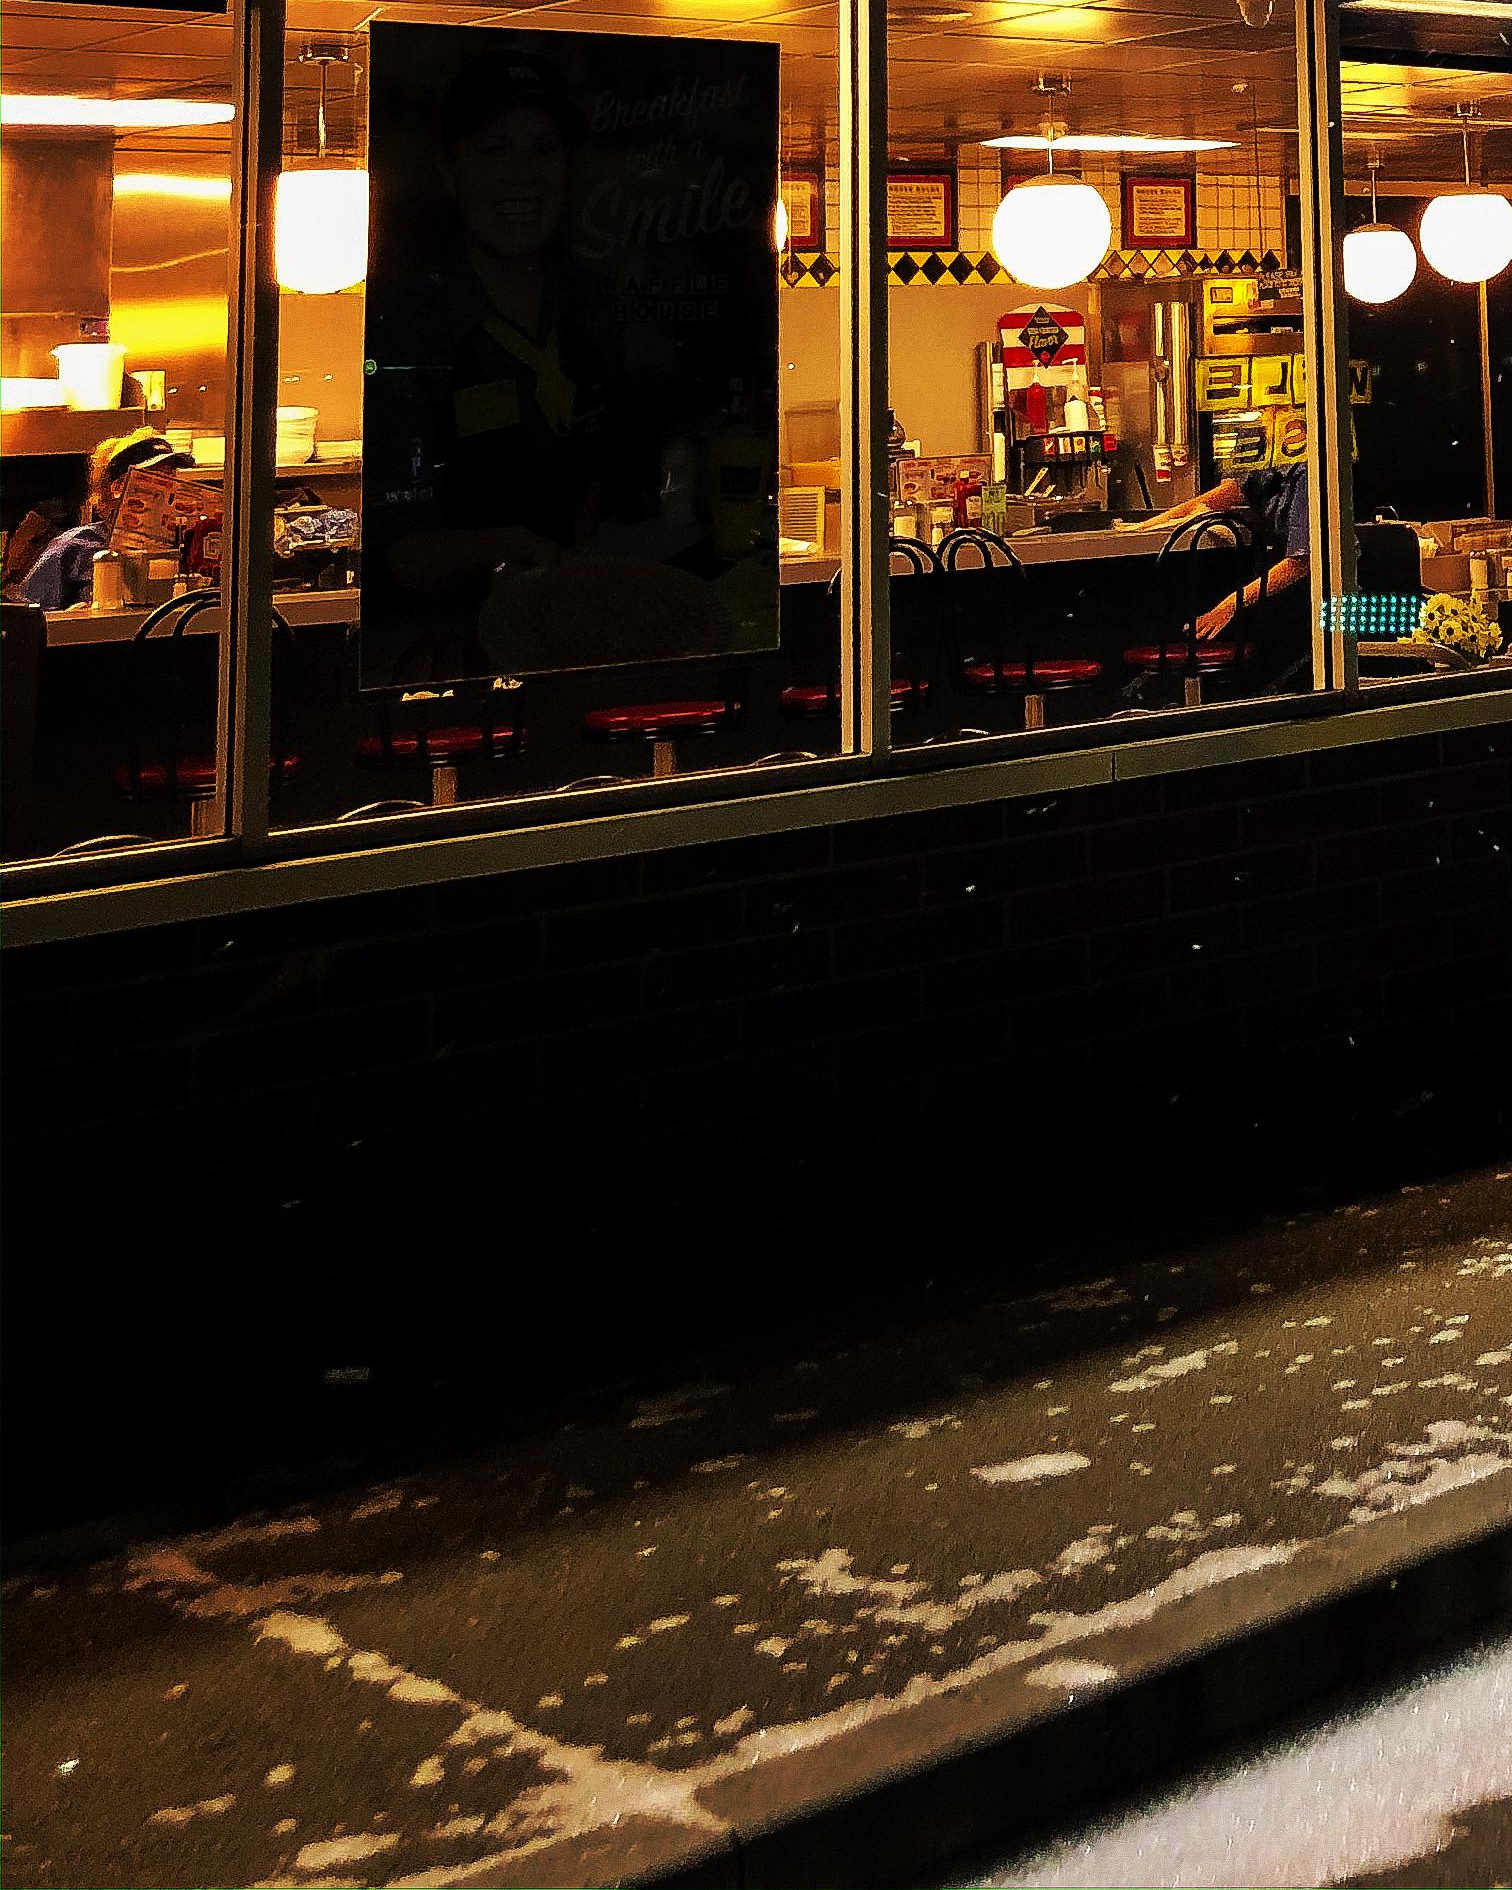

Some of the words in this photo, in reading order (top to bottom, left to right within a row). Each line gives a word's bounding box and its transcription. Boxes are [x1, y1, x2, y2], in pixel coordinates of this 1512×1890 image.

[591, 71, 748, 132] Breakfast
[625, 134, 677, 165] with
[571, 157, 754, 258] Smile
[601, 274, 729, 295] WAFFLE
[613, 301, 718, 321] HOUSE
